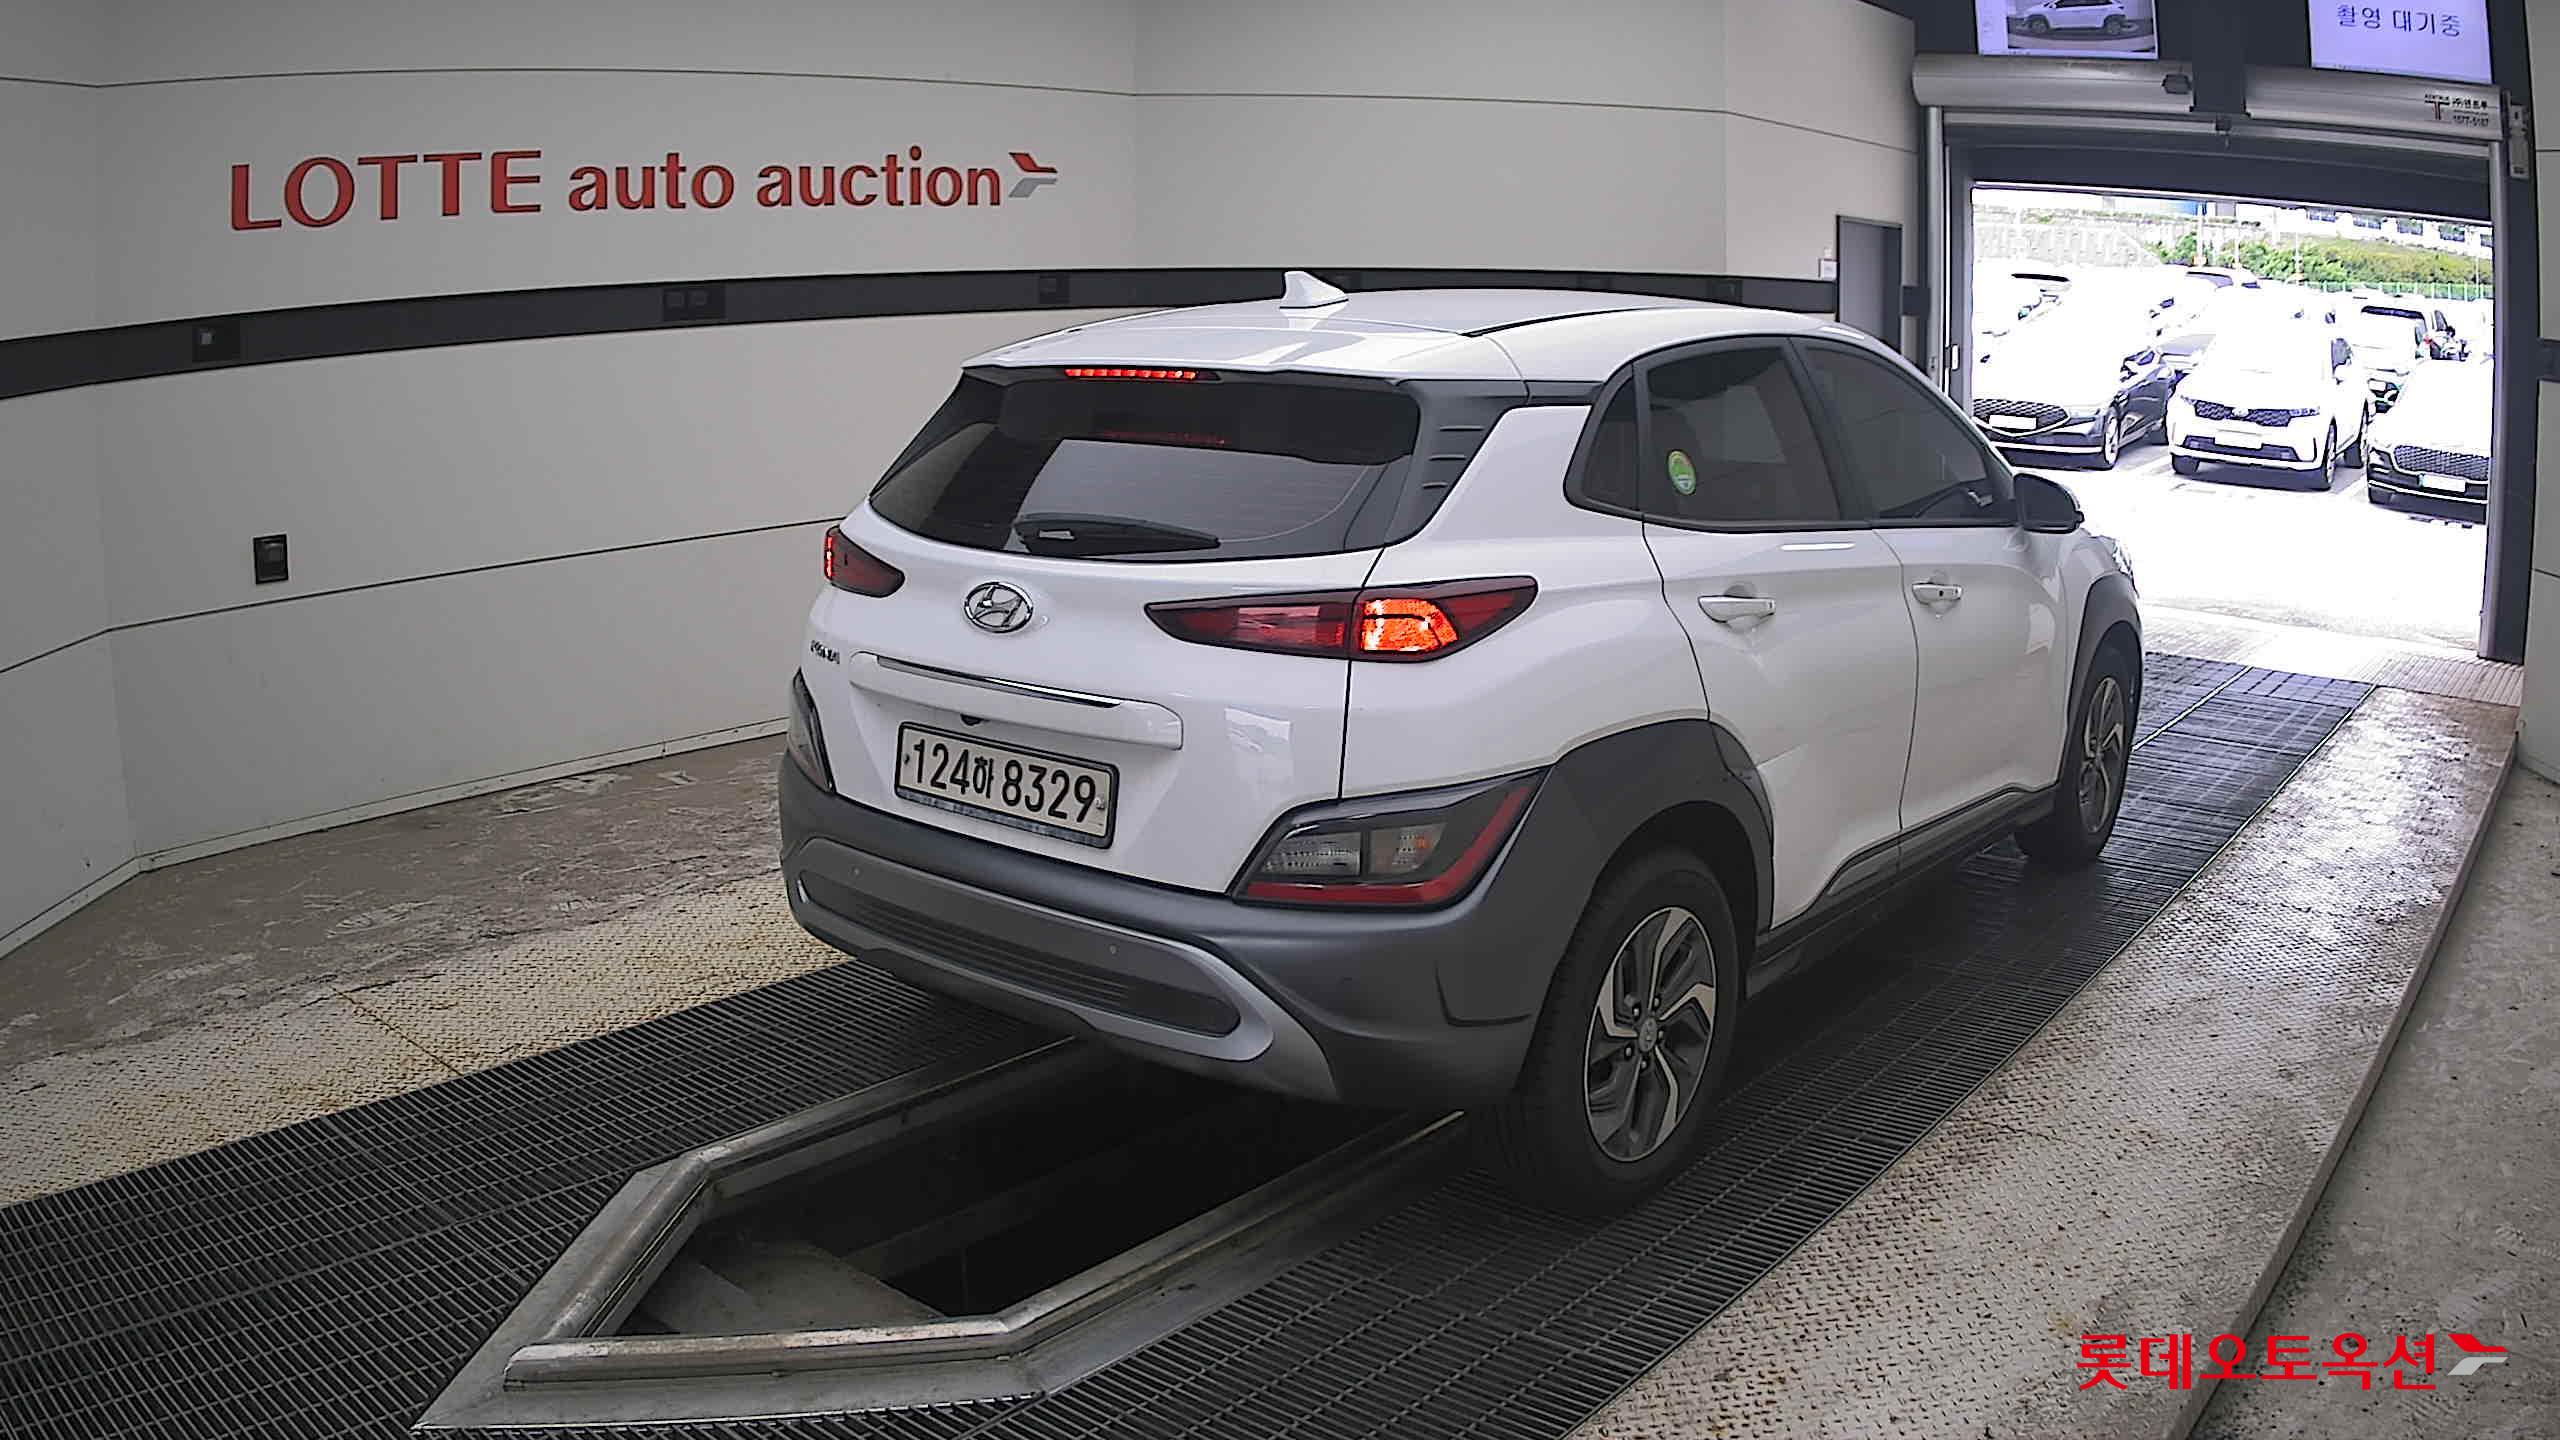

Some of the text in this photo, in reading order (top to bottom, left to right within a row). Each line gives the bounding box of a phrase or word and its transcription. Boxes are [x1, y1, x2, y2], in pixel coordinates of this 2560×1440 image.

[2337, 4, 2461, 37] 촬영 대기중
[231, 145, 1001, 231] LOTTE auto auction
[912, 738, 1097, 824] 124하 8329
